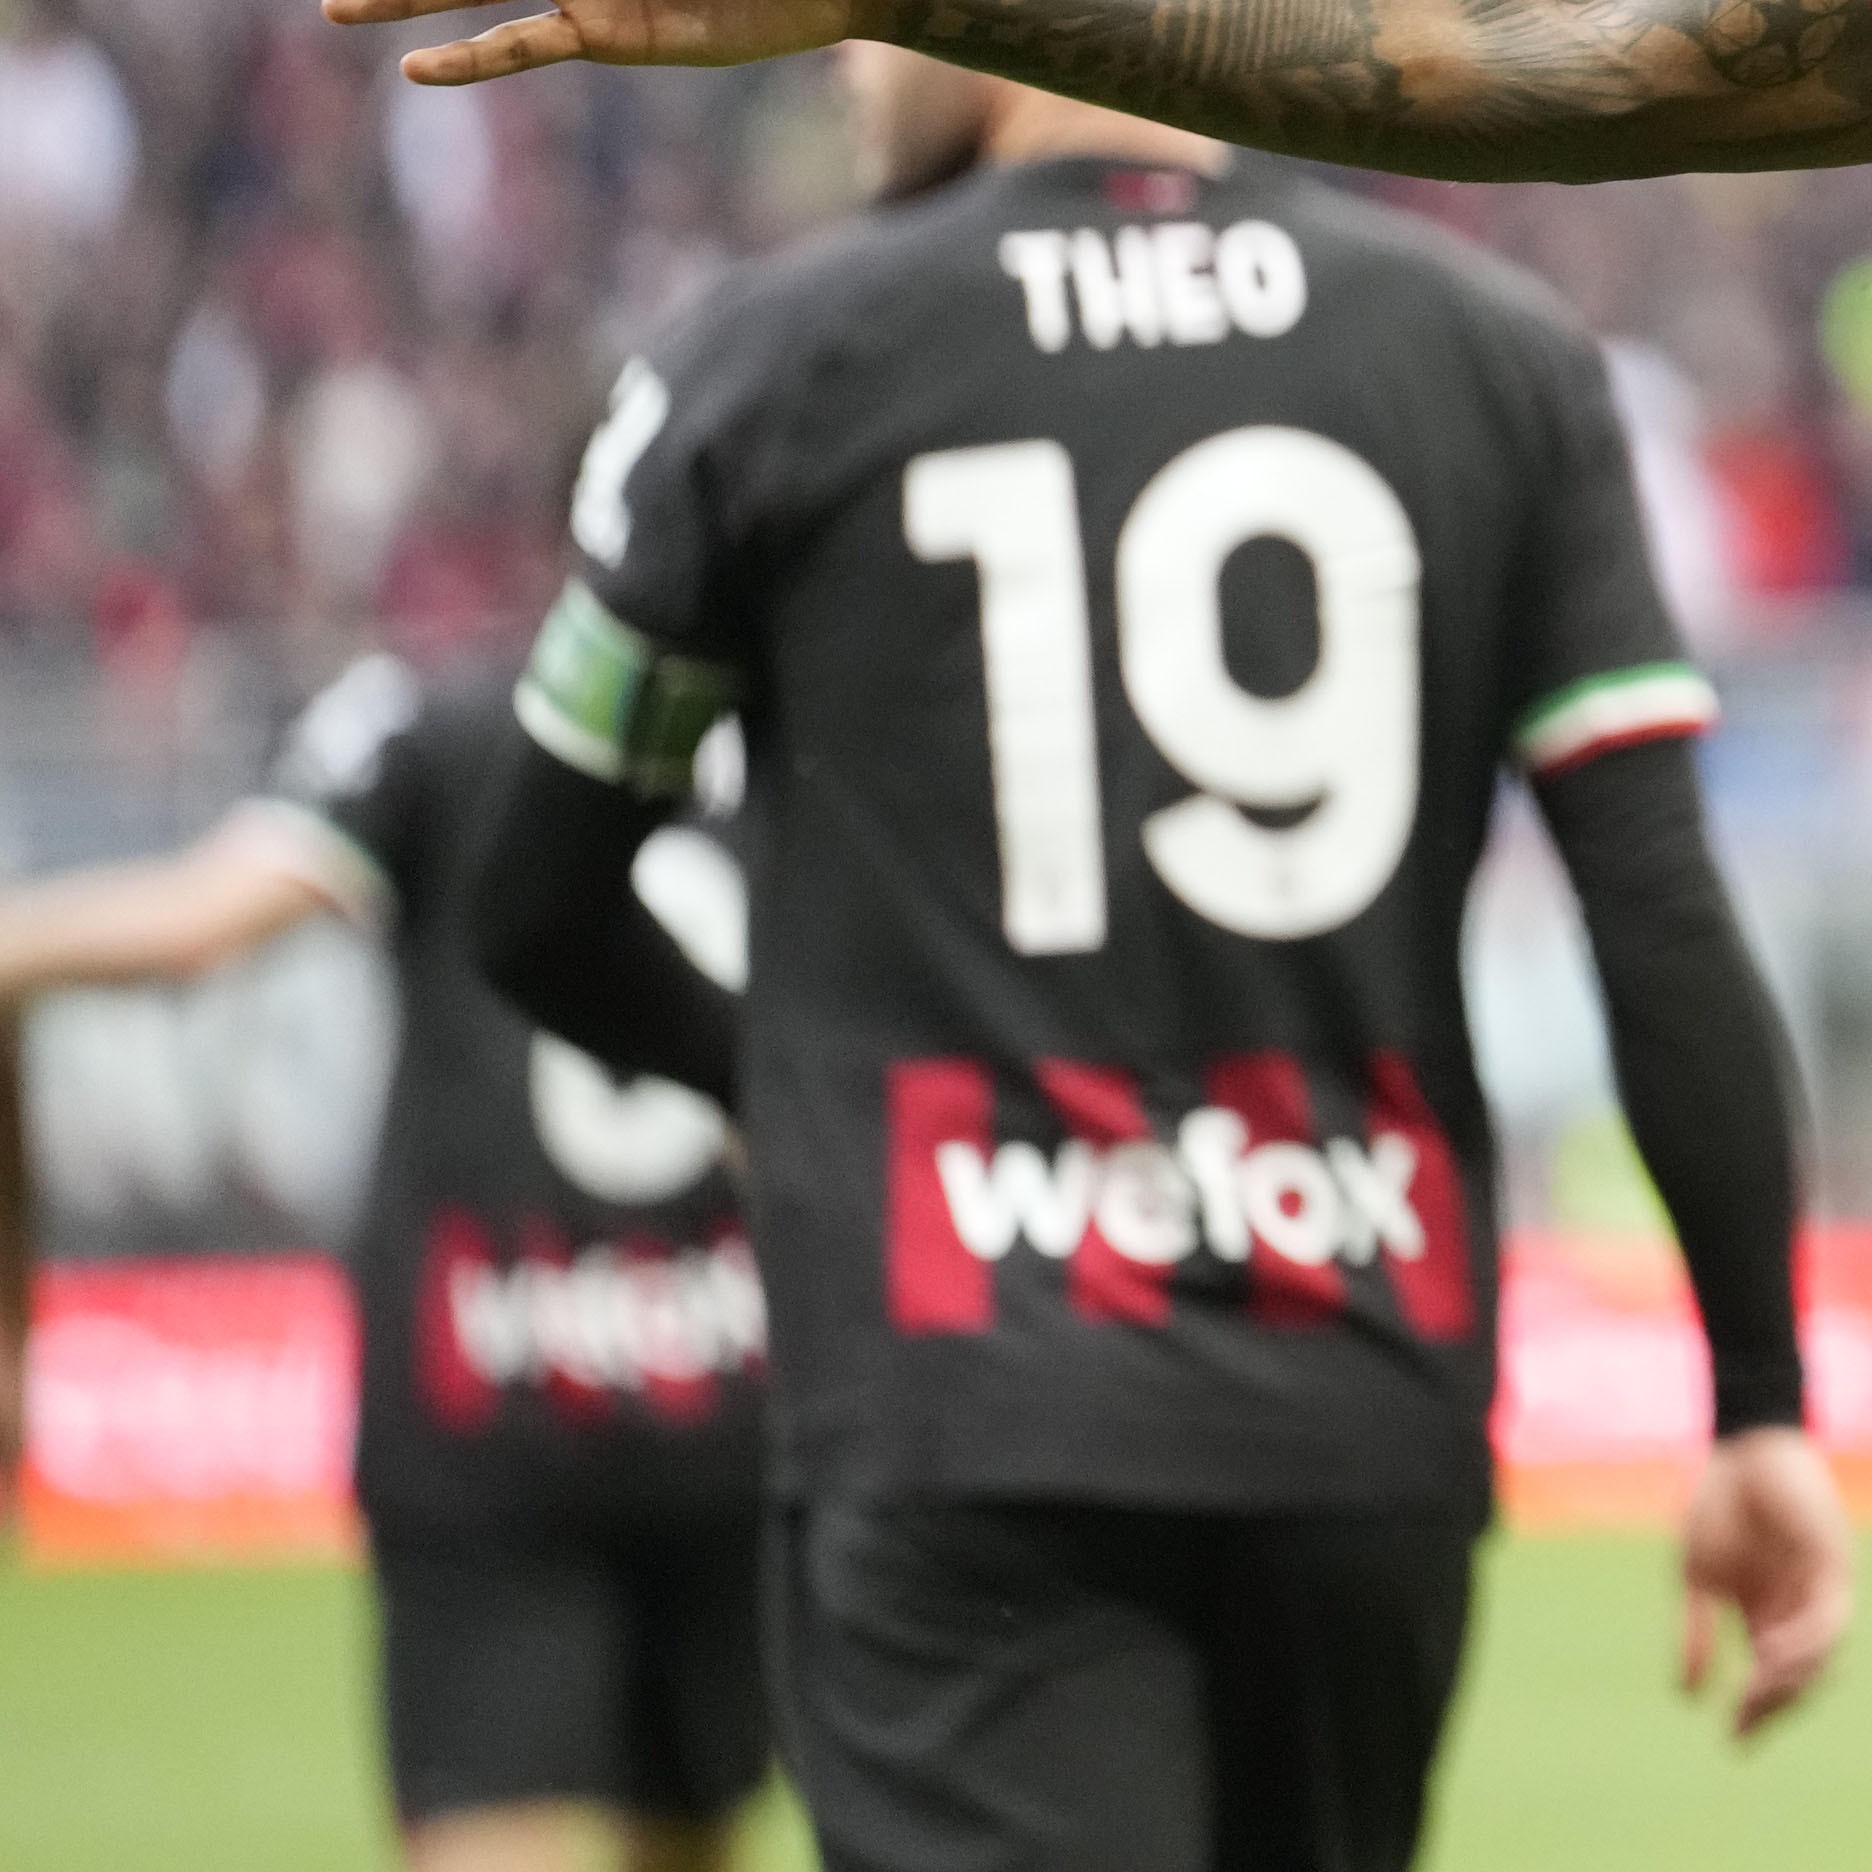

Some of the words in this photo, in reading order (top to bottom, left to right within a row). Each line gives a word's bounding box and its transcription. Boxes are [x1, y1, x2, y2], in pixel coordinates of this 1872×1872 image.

[997, 218, 1309, 354] THEO
[903, 424, 1422, 956] 19
[935, 1106, 1426, 1268] wefox
